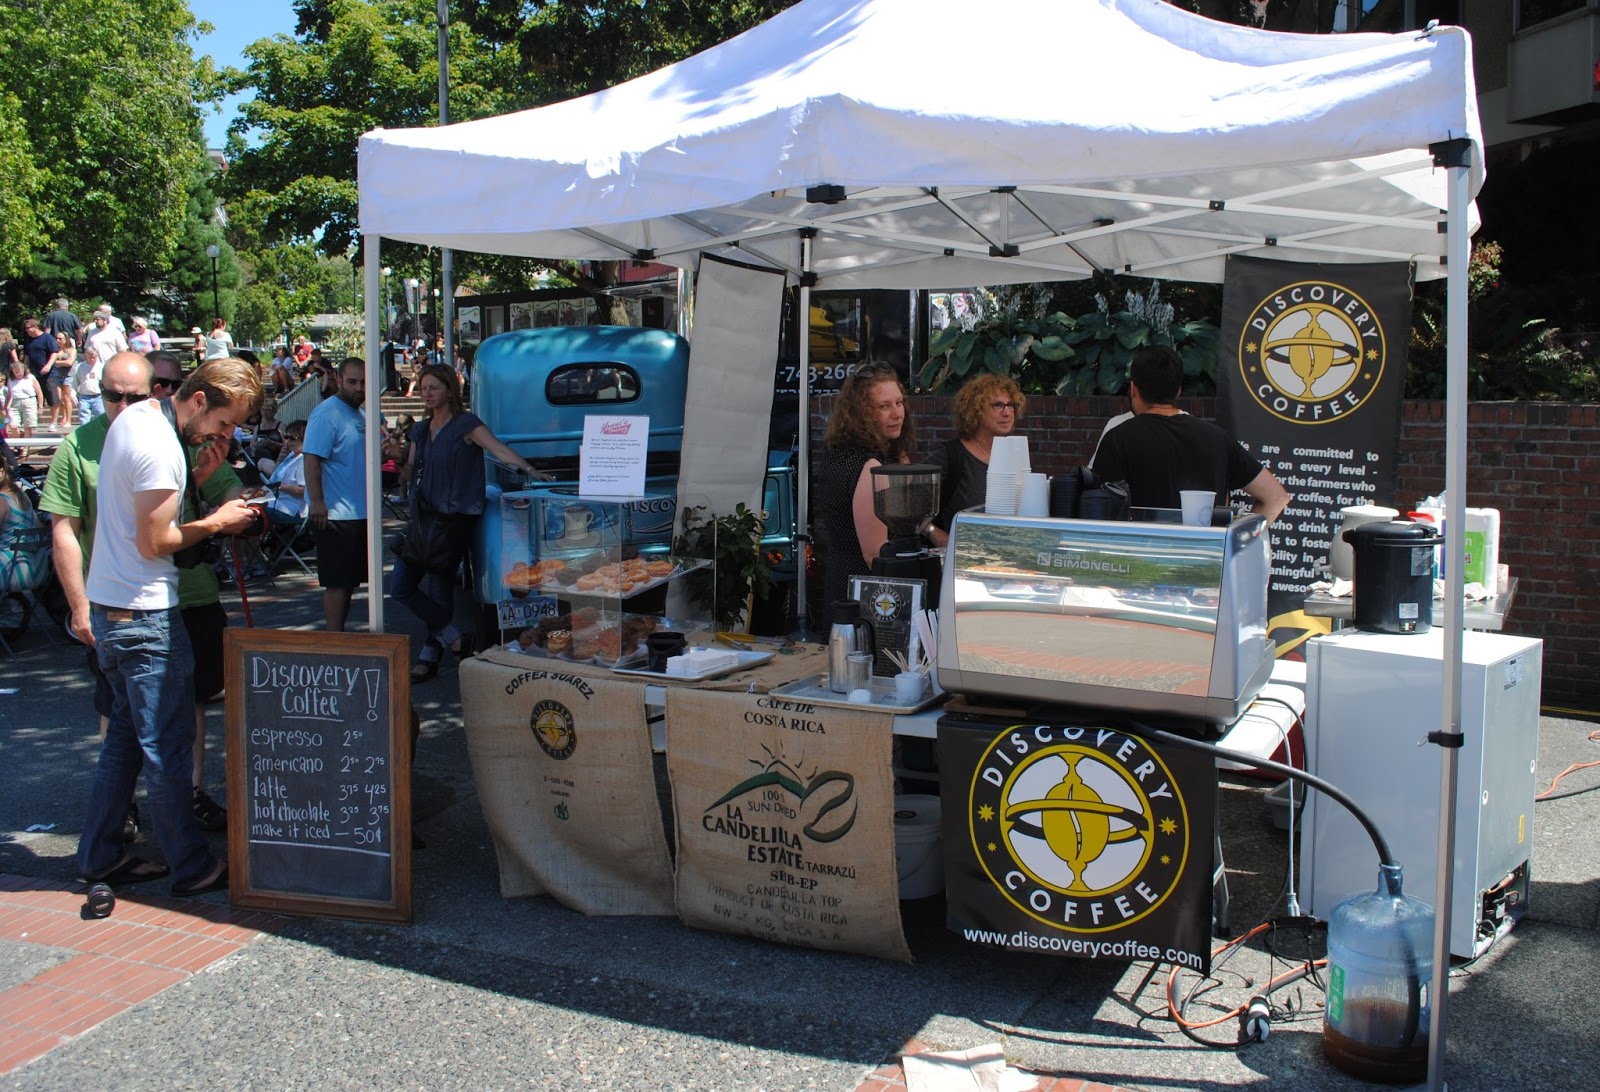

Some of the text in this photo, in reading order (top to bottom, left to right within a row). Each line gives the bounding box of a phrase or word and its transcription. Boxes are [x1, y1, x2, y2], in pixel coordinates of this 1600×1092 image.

[1251, 286, 1378, 339] DISCOVERY
[1258, 384, 1360, 420] COFFEE
[1262, 444, 1280, 454] are
[1292, 447, 1354, 460] committed
[1366, 452, 1379, 462] to
[1278, 460, 1293, 470] on
[1300, 463, 1331, 475] every
[1338, 464, 1366, 476] level
[1288, 475, 1306, 487] the
[1307, 476, 1350, 490] farmers
[1351, 480, 1376, 492] who
[1297, 492, 1334, 505] coffee,
[1336, 495, 1352, 505] for
[1355, 496, 1375, 507] the
[1284, 506, 1312, 517] brew
[1315, 507, 1326, 520] it,
[1329, 510, 1345, 520] an
[1270, 519, 1293, 531] who
[1298, 522, 1328, 534] drink
[1271, 535, 1332, 549] is to foste
[1053, 559, 1130, 573] SIMONELLI
[1303, 552, 1314, 563] in
[1272, 581, 1309, 593] aweso
[251, 656, 360, 696] Discovery
[505, 671, 595, 700] COFFEA SUAREZ
[281, 686, 340, 717] Coffee
[793, 701, 815, 715] DE
[744, 711, 826, 734] COSTA RICA
[251, 728, 323, 751] espresso
[253, 754, 324, 773] americano
[982, 725, 1173, 800] DISCOVERY
[253, 776, 288, 799] latte
[253, 799, 277, 821] hot
[278, 801, 331, 823] chocolate
[726, 804, 744, 822] LA
[748, 801, 770, 813] SUN
[252, 824, 283, 838] make
[288, 824, 300, 839] it
[304, 824, 330, 839] iced
[702, 815, 802, 850] CANDELILLA
[747, 845, 856, 879] ESTATE TARRAZÚ
[769, 869, 818, 891] SHB-EP
[821, 895, 842, 908] TOP
[1005, 870, 1159, 925] COFFEE
[820, 912, 848, 926] RICA
[963, 928, 1203, 970] www.discoverycoffee.com
